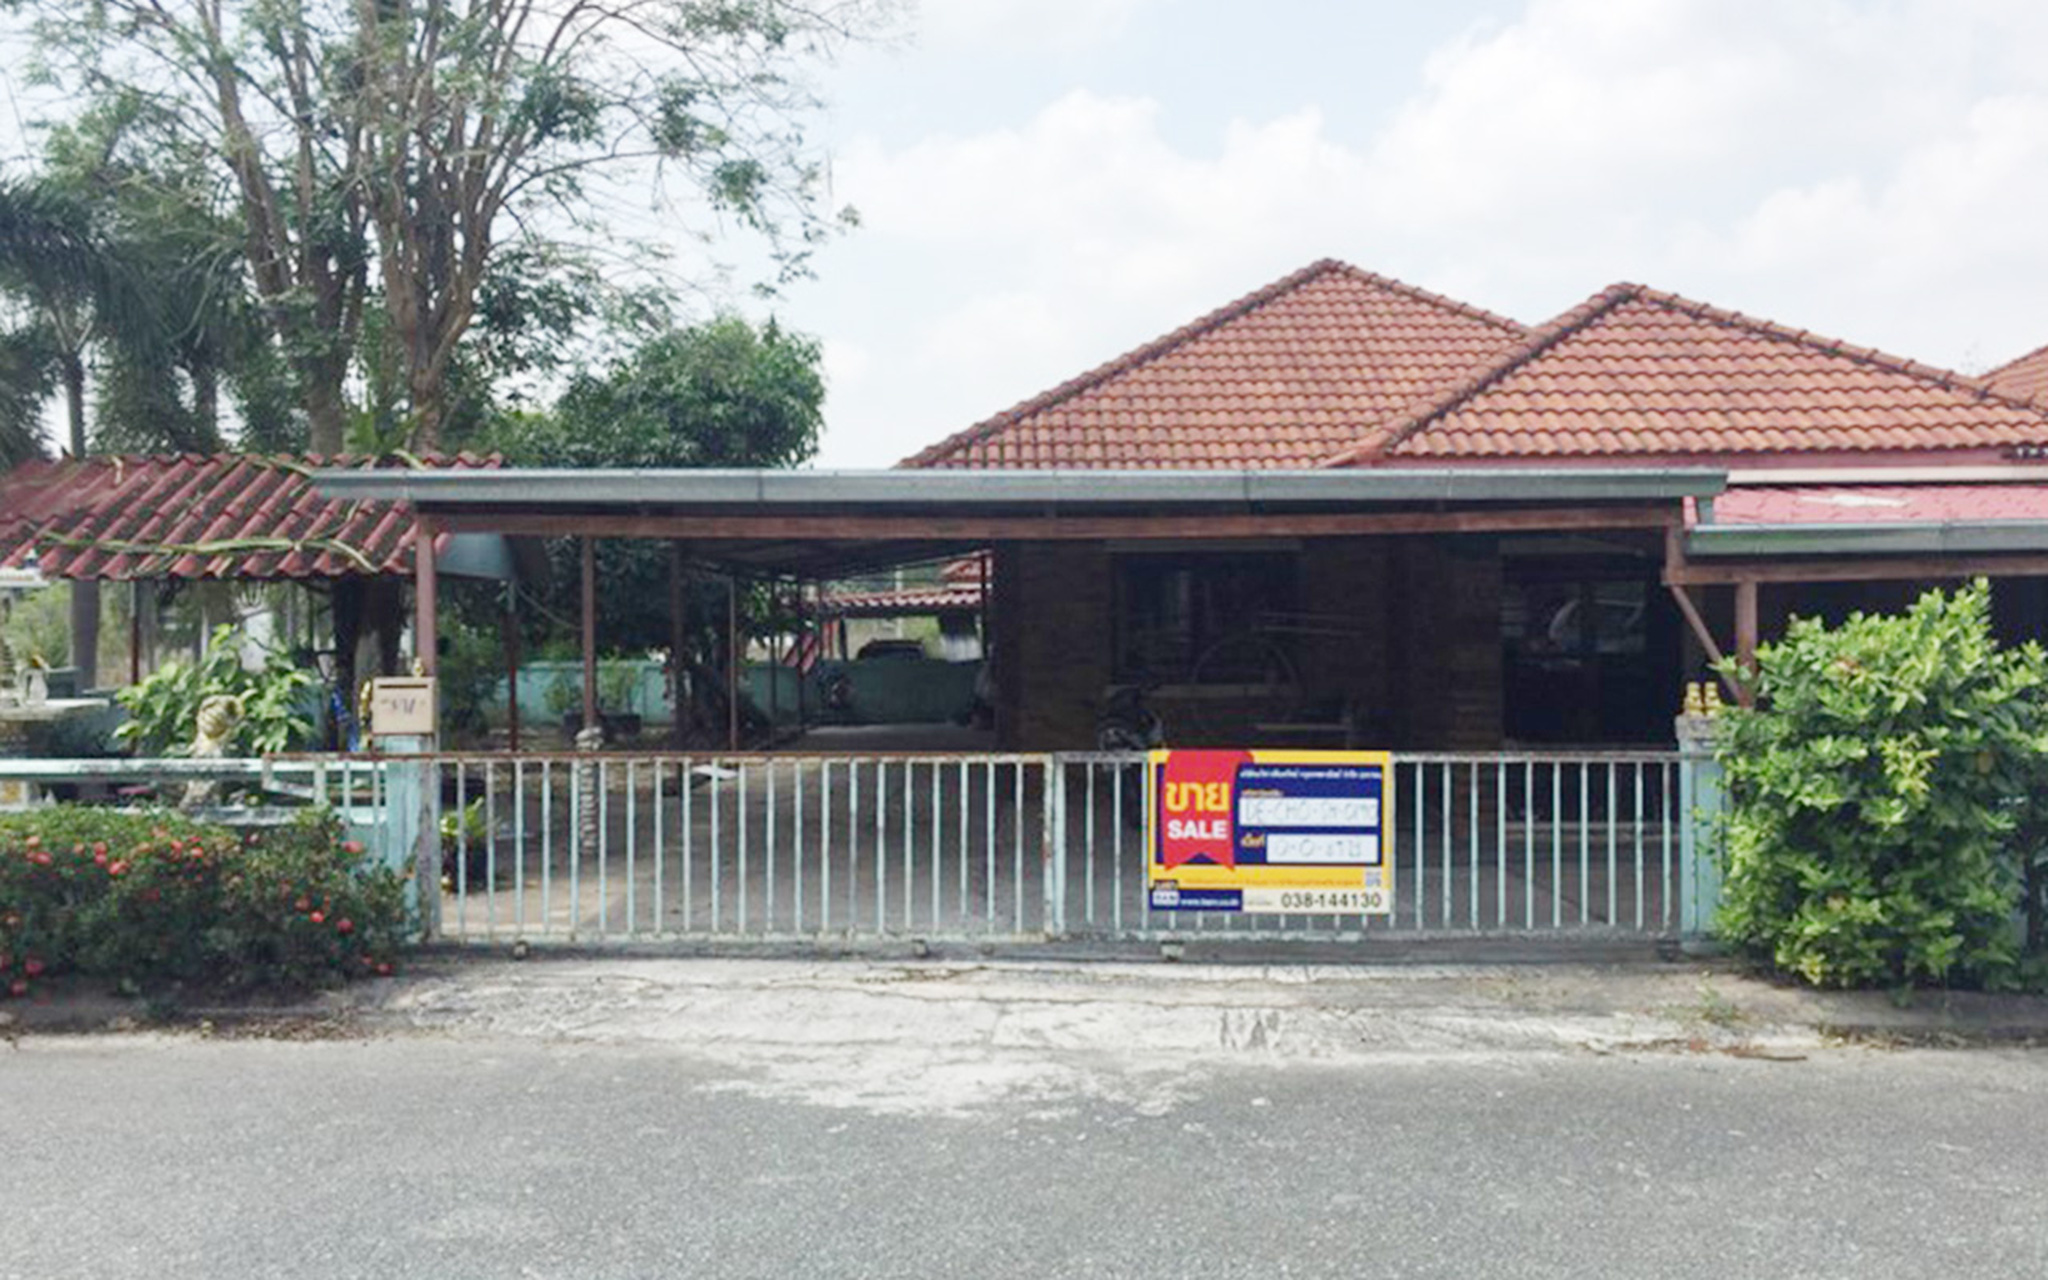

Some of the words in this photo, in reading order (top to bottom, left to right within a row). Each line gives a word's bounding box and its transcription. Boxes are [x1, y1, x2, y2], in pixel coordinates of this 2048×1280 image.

[1166, 781, 1230, 812] ขาย
[1167, 819, 1228, 839] SALE
[1281, 892, 1382, 908] 038-144130
